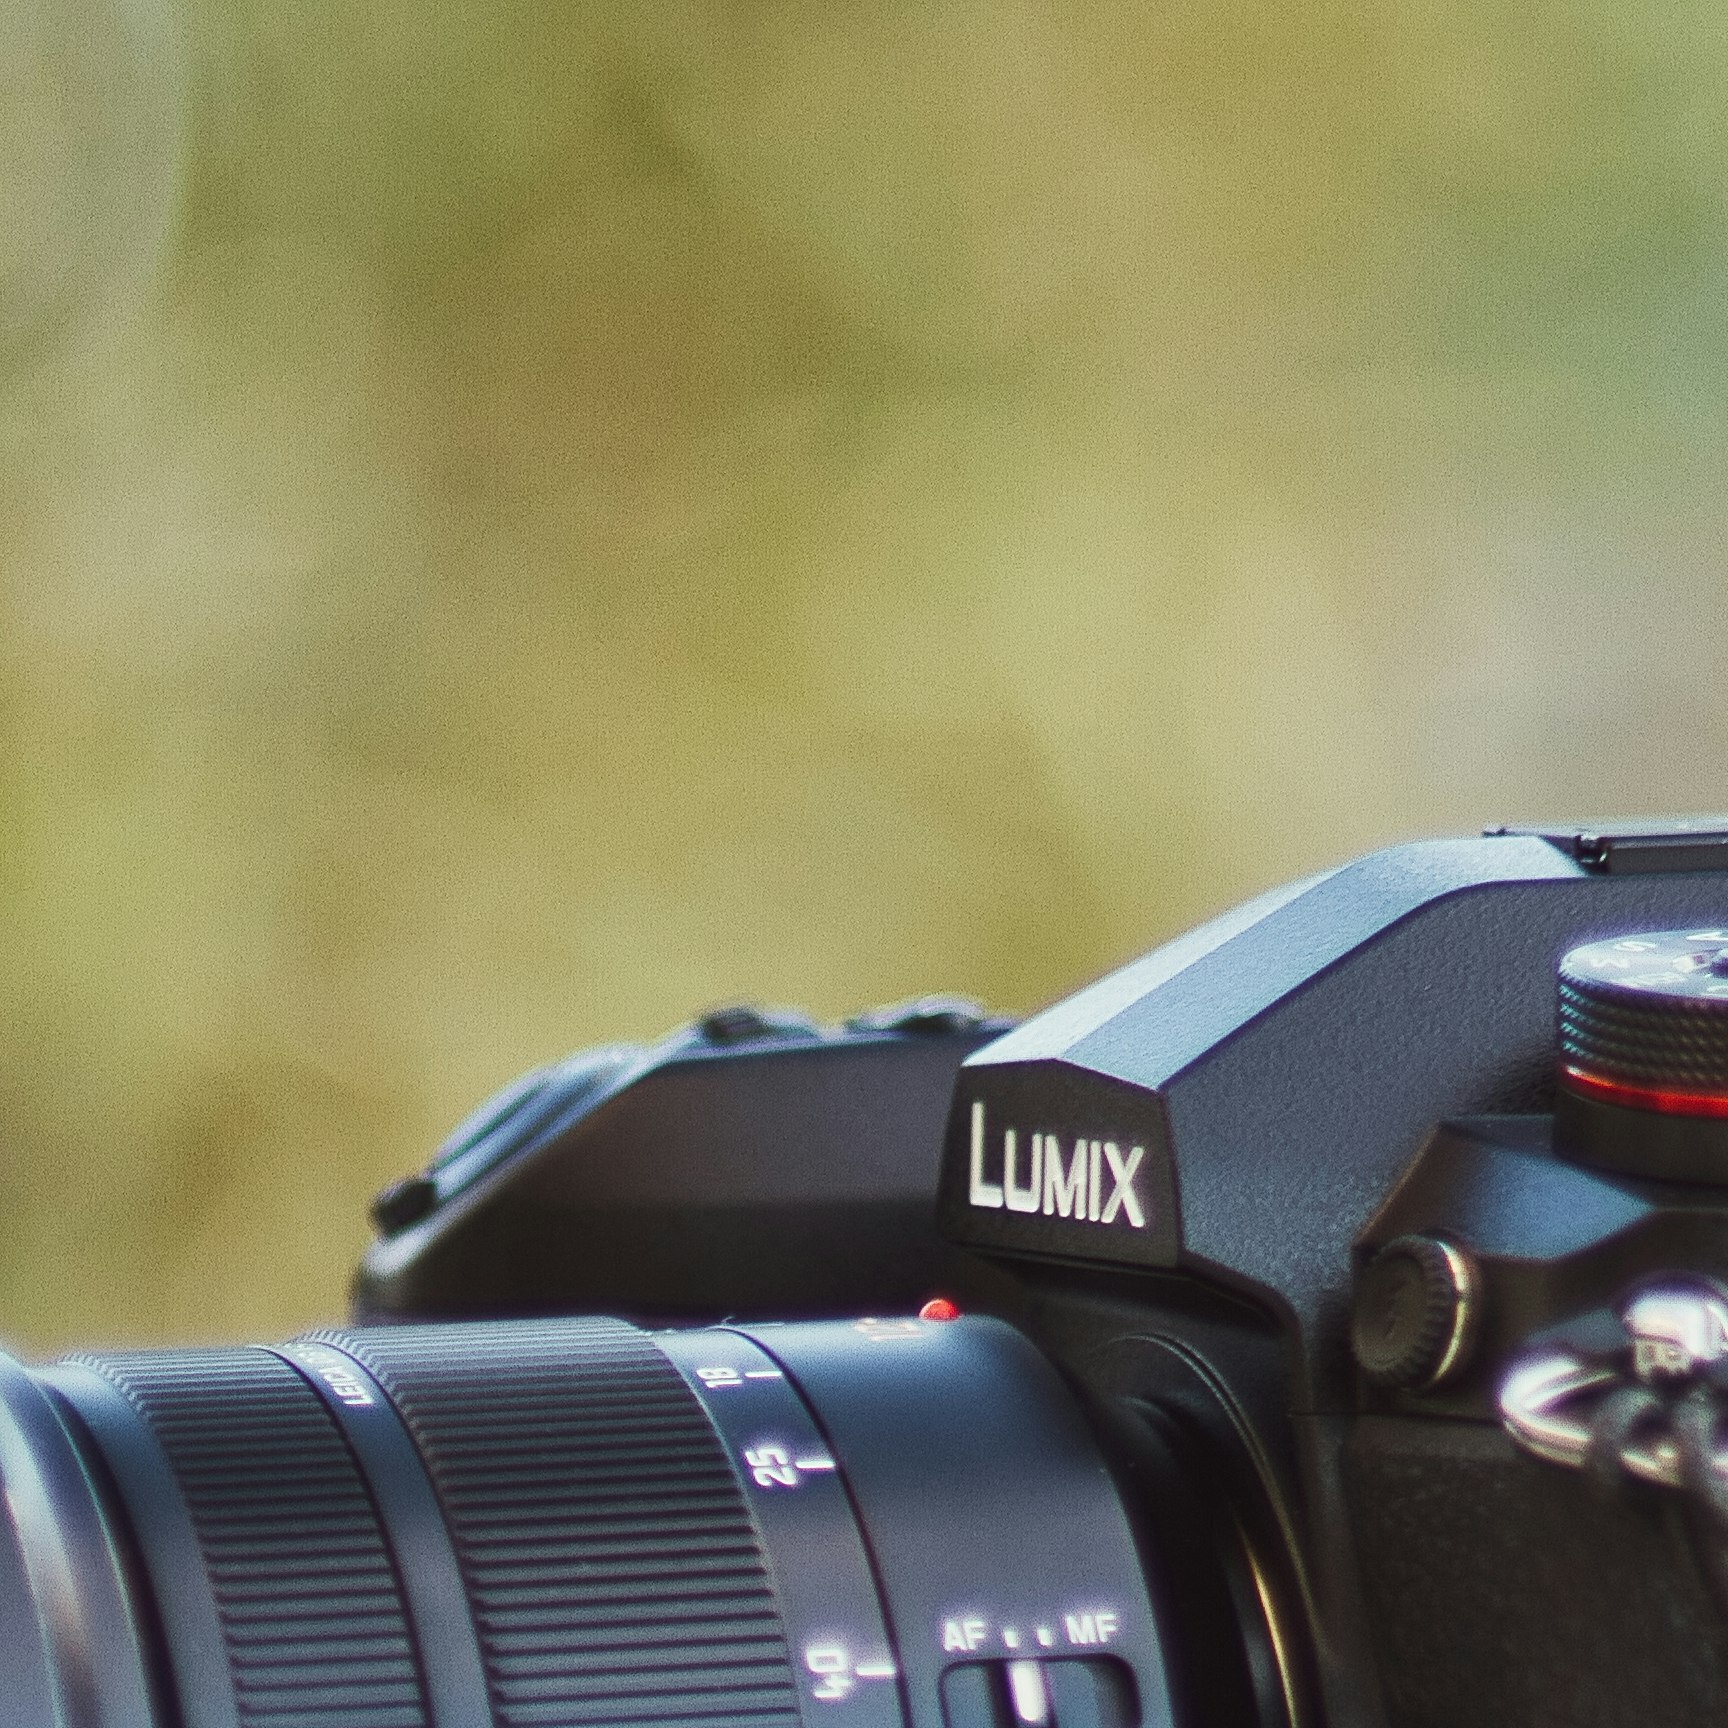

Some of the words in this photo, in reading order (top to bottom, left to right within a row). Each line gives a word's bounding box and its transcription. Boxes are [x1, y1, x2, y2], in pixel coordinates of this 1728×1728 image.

[969, 1100, 1146, 1228] LUMIX
[696, 1366, 743, 1389] 18
[744, 1446, 799, 1487] 25
[943, 1616, 986, 1651] AF
[1064, 1611, 1118, 1645] MF
[806, 1648, 853, 1699] 40
